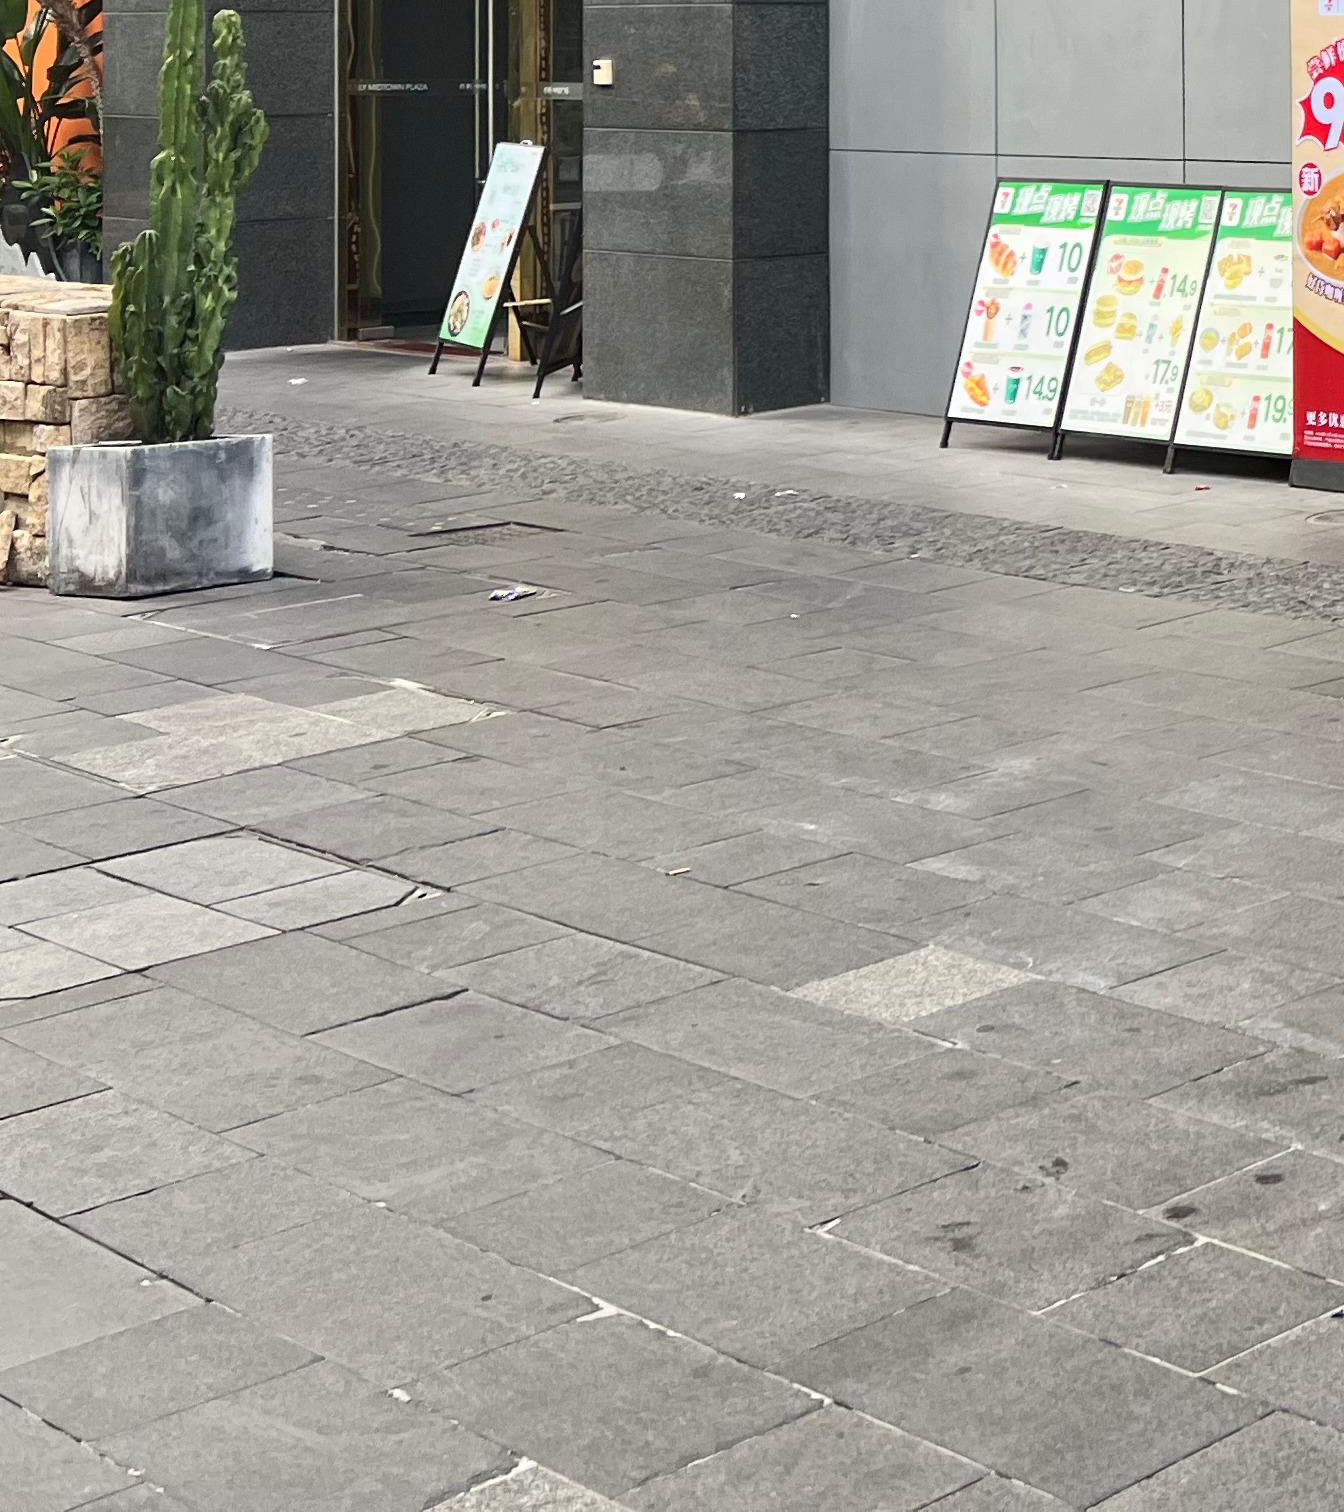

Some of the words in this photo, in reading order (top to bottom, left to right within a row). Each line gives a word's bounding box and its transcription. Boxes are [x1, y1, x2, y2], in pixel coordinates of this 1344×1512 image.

[1300, 167, 1321, 194] 新
[1057, 241, 1084, 273] 10
[1045, 305, 1071, 337] 10
